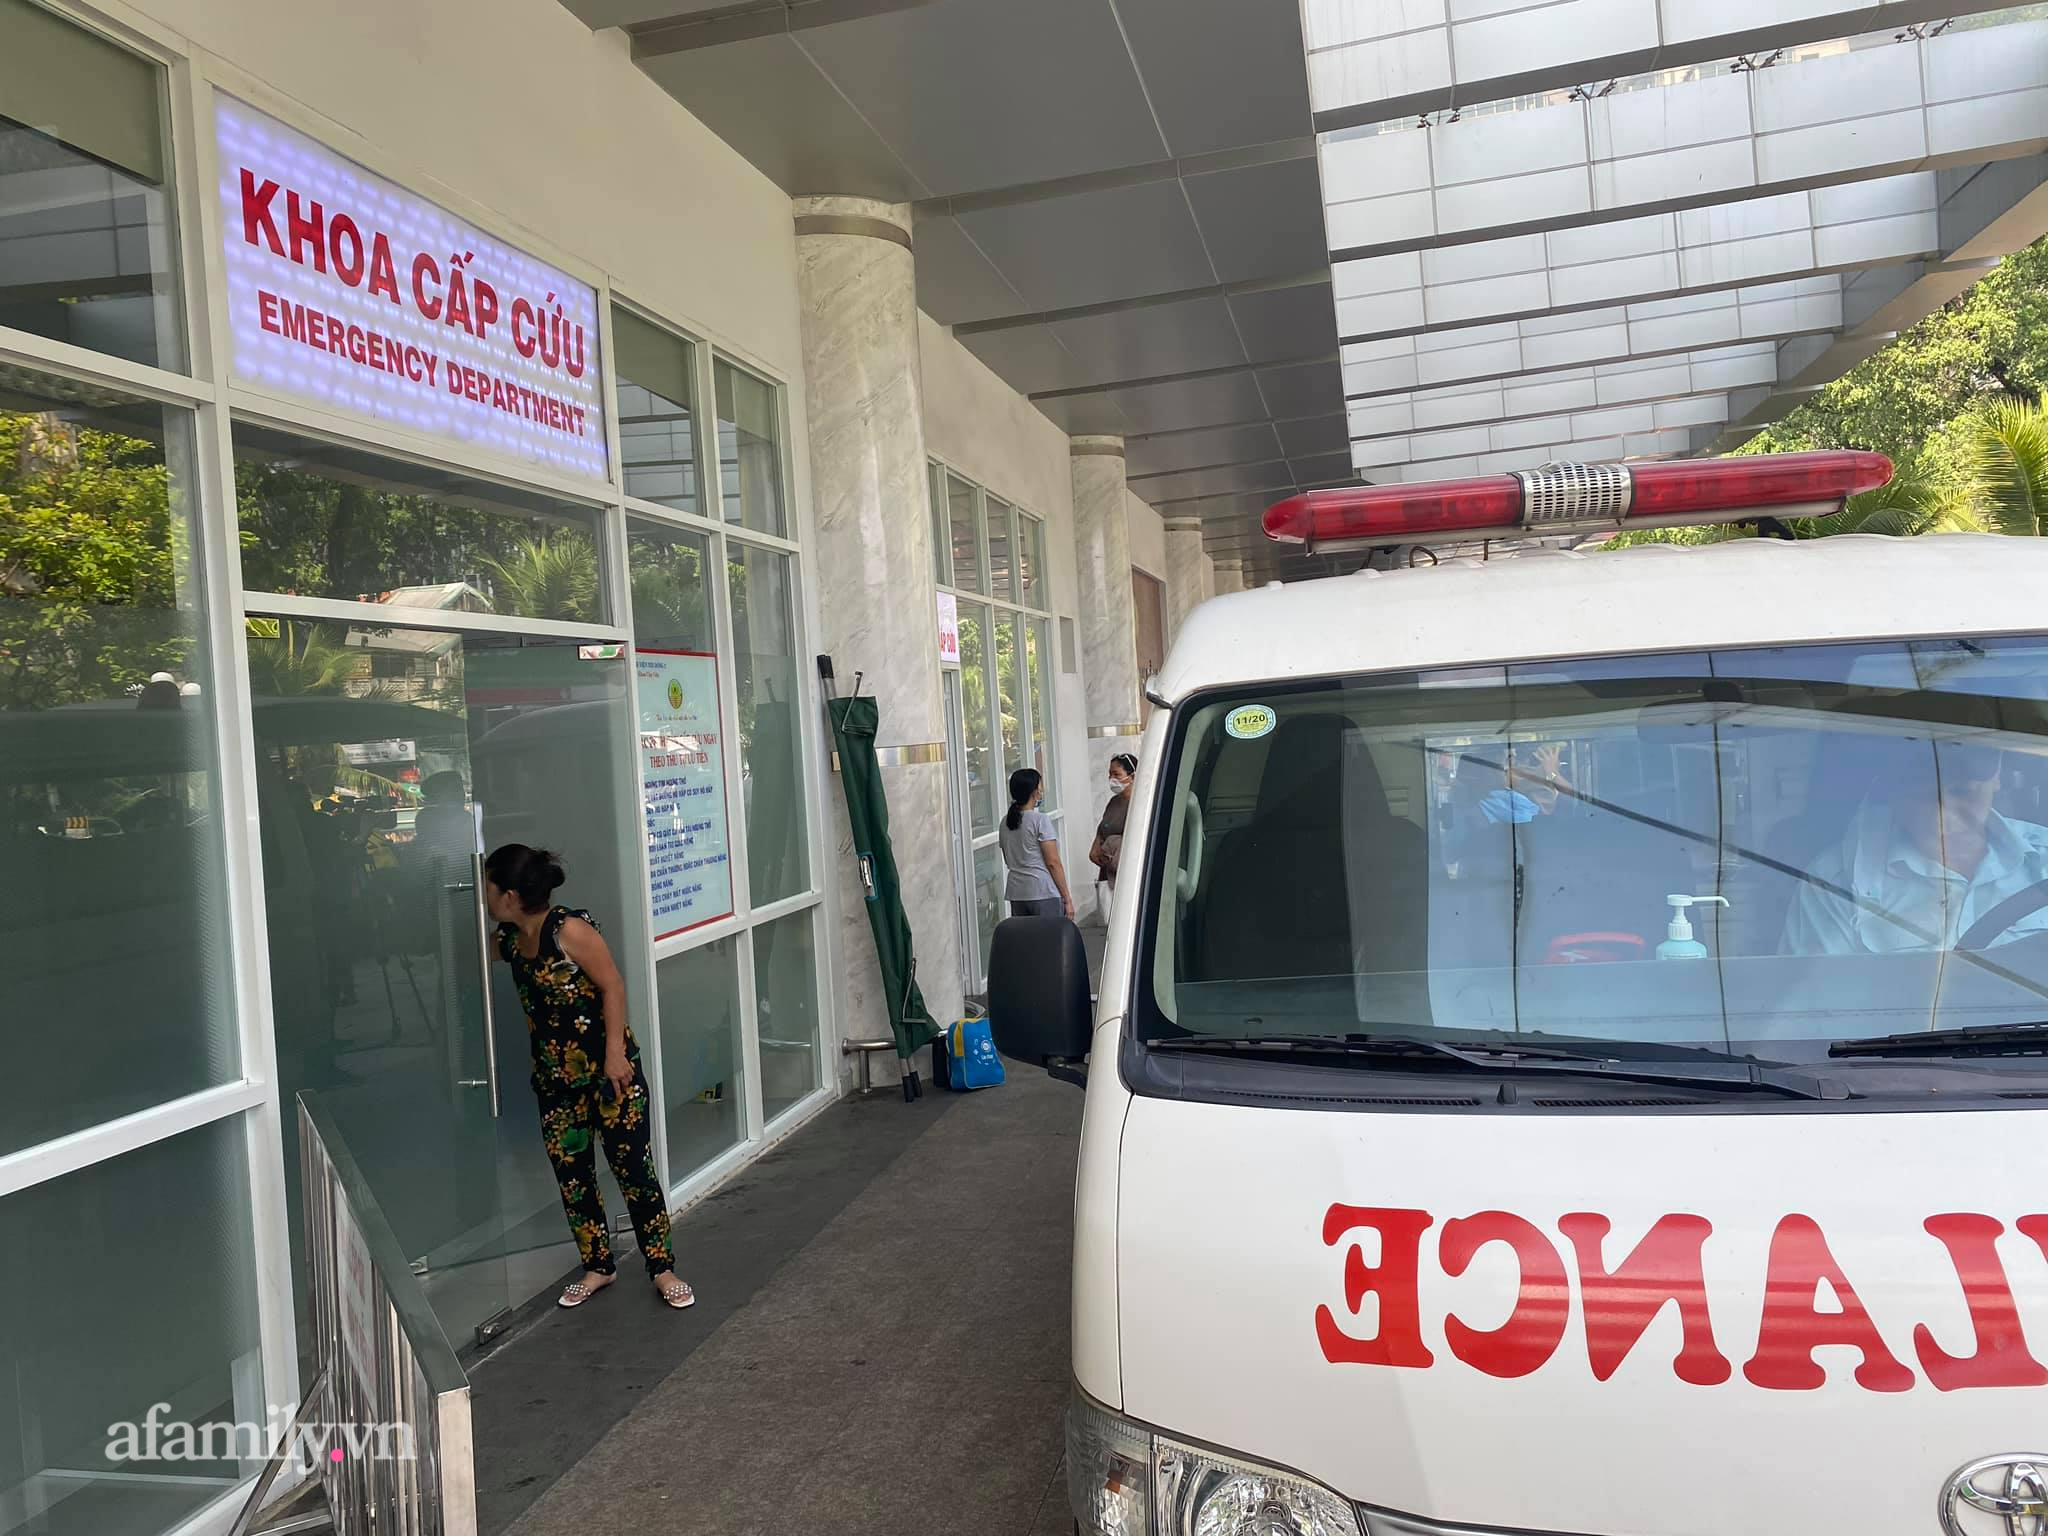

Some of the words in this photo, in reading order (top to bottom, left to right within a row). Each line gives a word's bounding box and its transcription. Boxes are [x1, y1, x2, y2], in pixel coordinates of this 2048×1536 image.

[240, 167, 401, 306] KHOA
[411, 251, 499, 340] CẤP
[511, 293, 584, 378] CỨU
[258, 290, 438, 387] EMERGENCY
[447, 360, 584, 437] DEPARTMENT
[1236, 714, 1266, 725] 11/20
